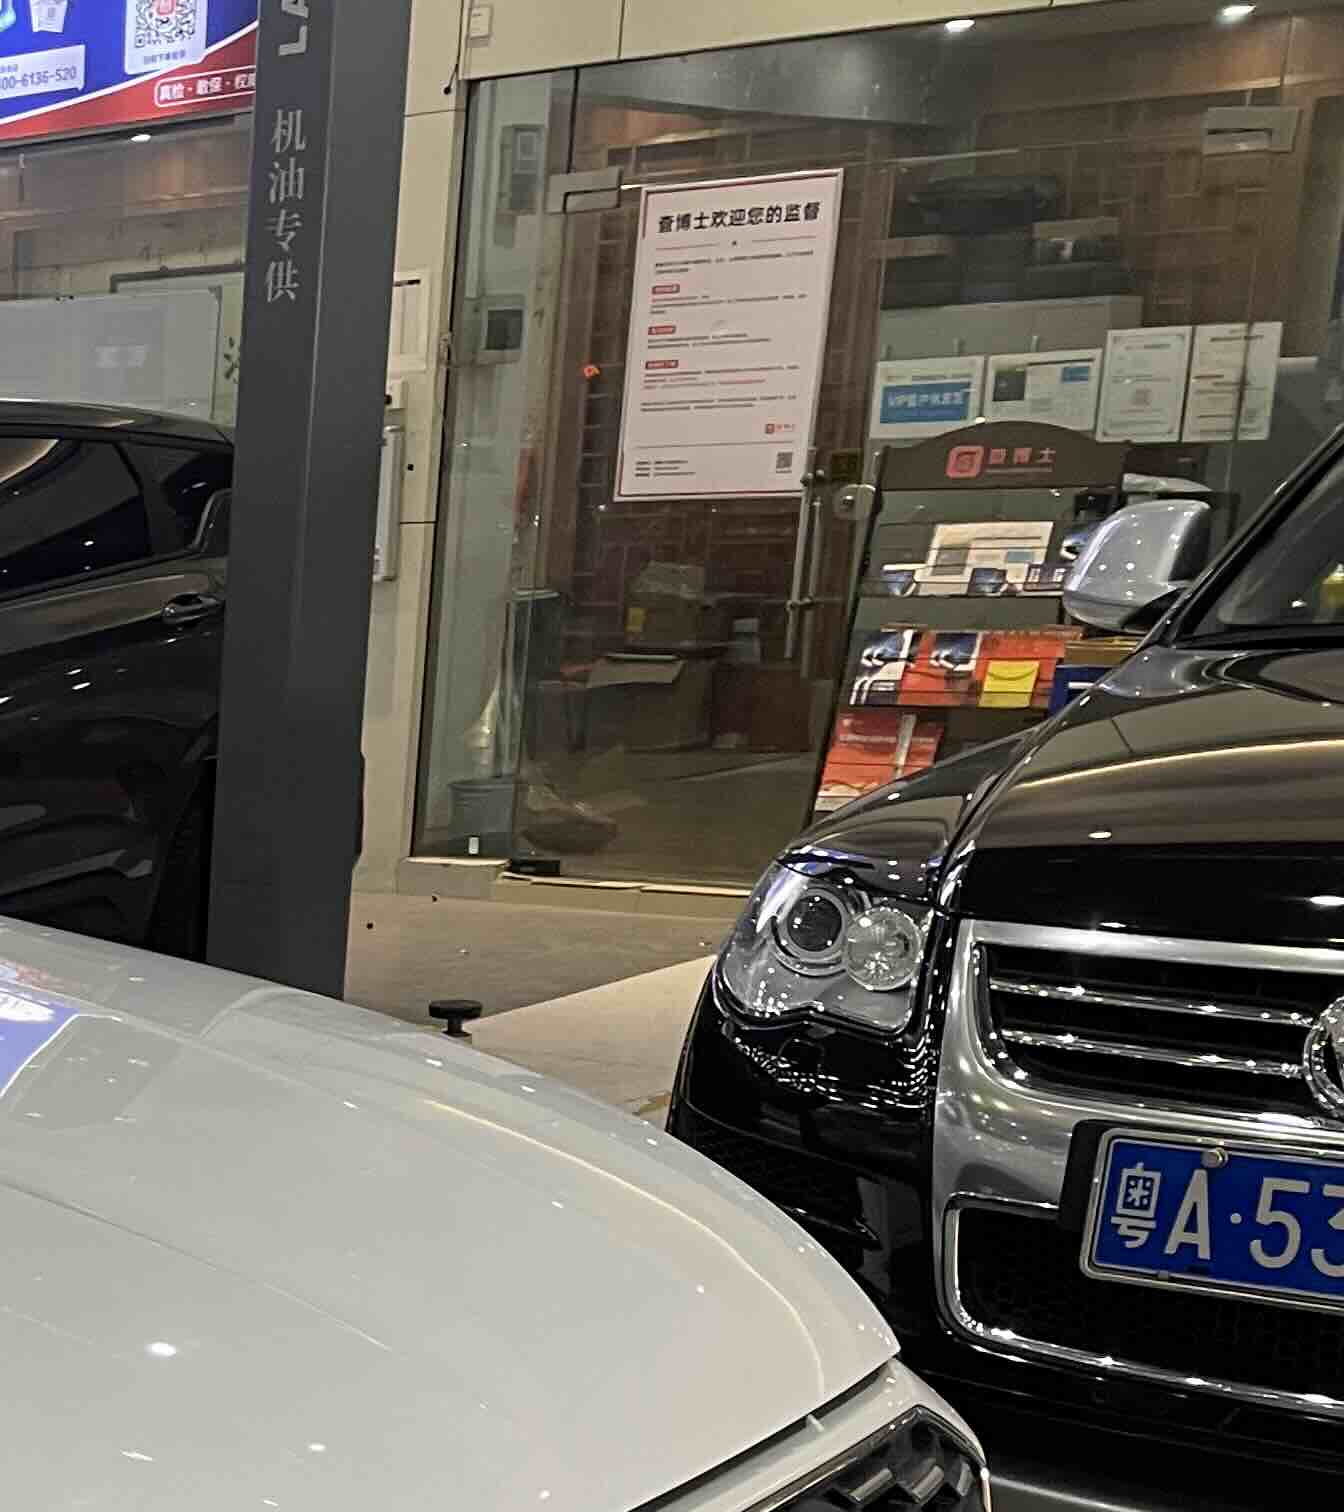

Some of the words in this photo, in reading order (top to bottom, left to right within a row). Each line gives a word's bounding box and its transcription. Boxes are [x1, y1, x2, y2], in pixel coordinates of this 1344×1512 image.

[264, 108, 308, 303] 机油专供
[658, 200, 821, 234] 查博士欢迎您的监督
